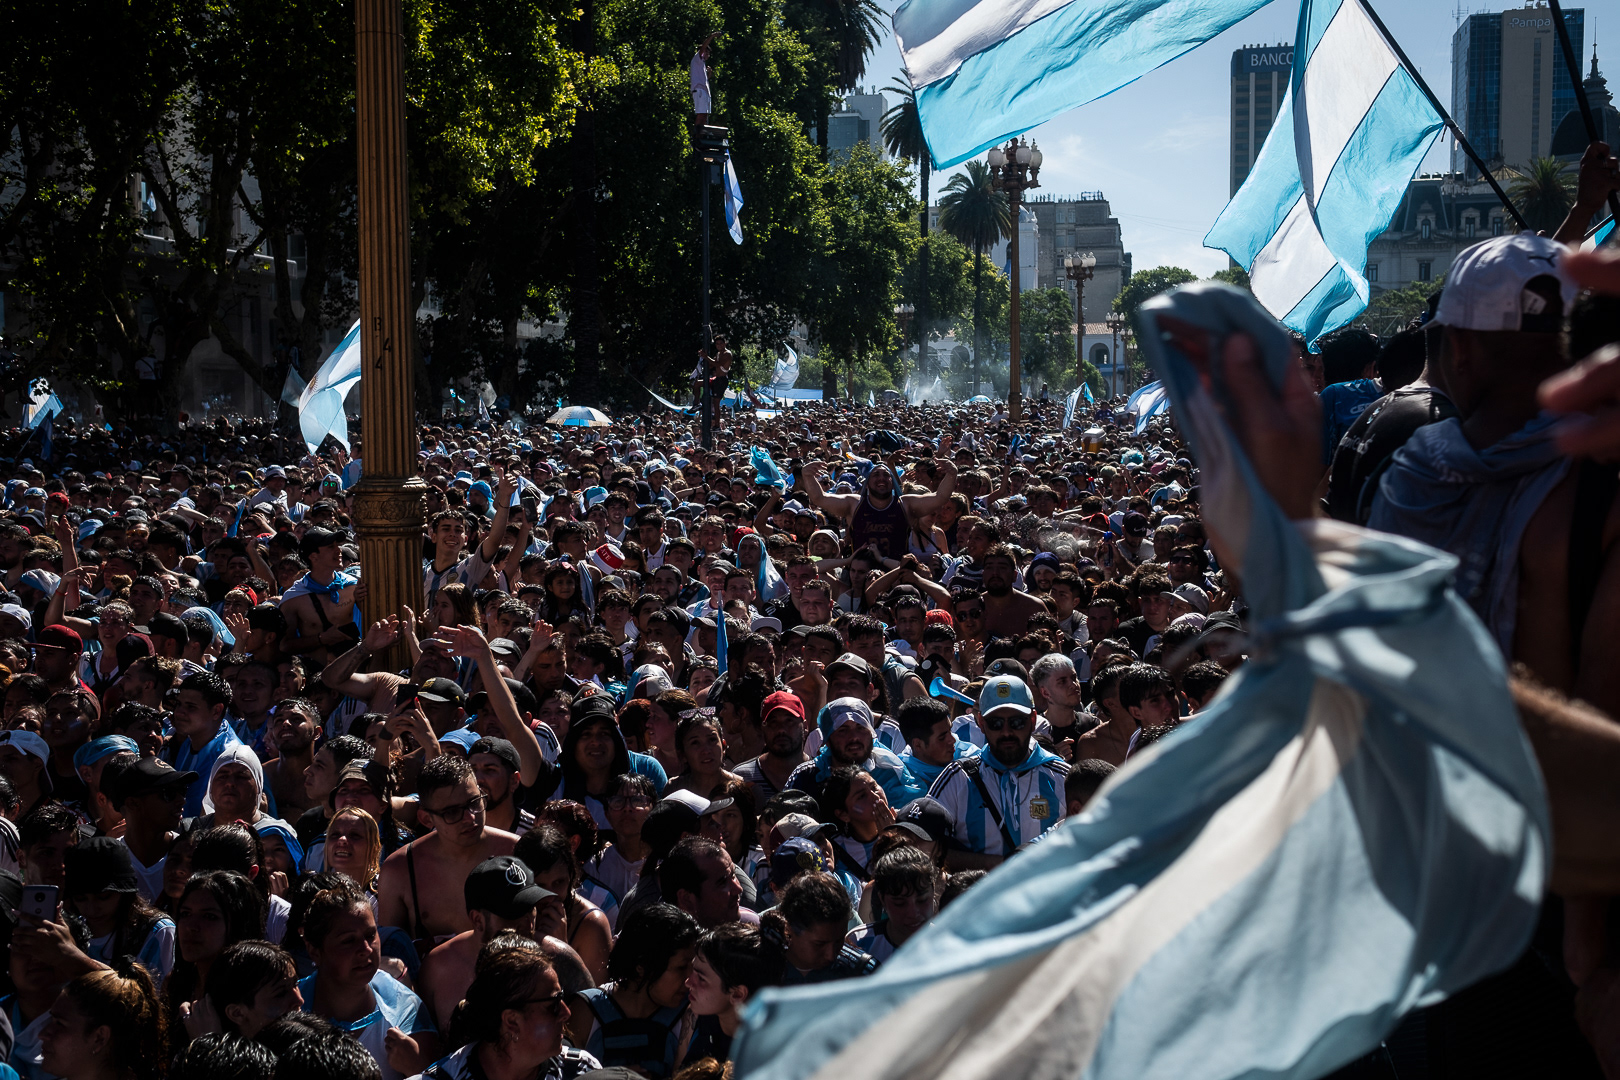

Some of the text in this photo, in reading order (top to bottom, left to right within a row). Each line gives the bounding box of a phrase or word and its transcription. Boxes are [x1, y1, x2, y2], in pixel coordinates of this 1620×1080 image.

[1509, 17, 1551, 29] Pampa
[1251, 52, 1294, 66] BANCO
[908, 802, 923, 819] LA
